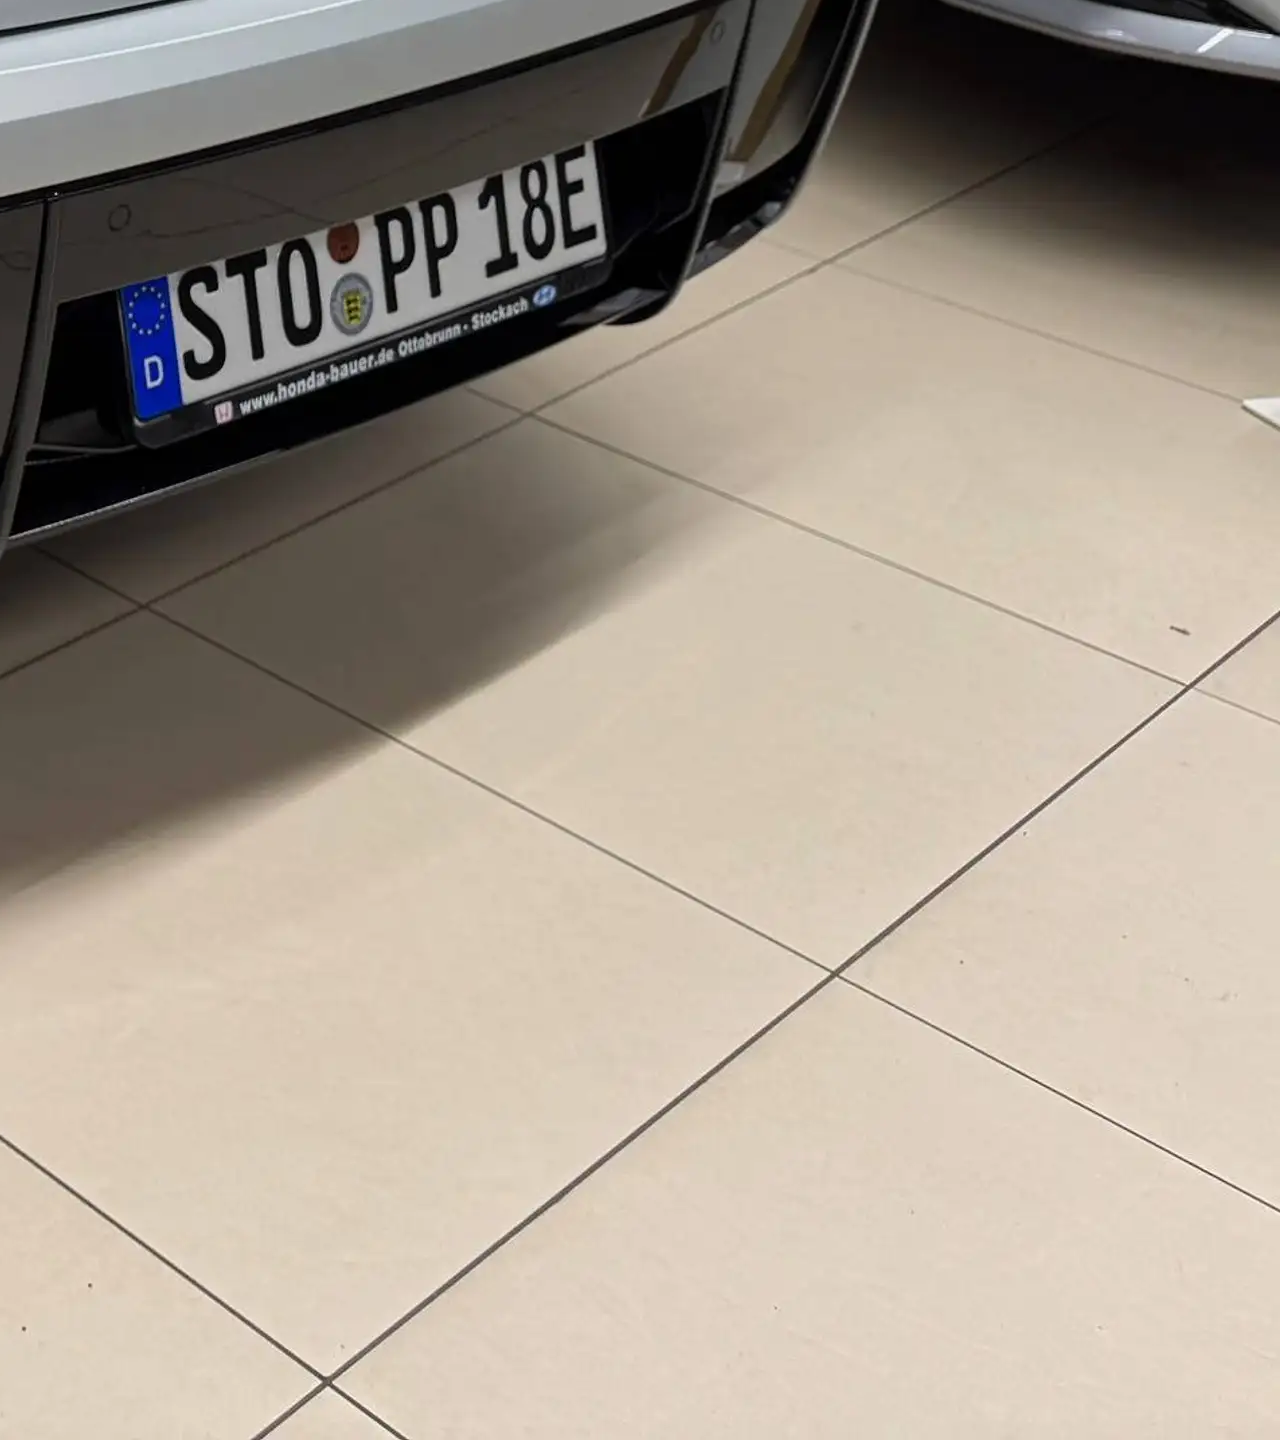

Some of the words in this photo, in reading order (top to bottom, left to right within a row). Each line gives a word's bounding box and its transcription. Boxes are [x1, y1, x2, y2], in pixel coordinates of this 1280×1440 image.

[177, 237, 323, 381] STO
[373, 192, 459, 315] PP
[477, 144, 597, 279] 18E
[143, 354, 165, 390] D
[239, 347, 395, 416] www.honda-bauer.de
[397, 323, 461, 358] Ottobrunn
[471, 296, 530, 331] Stockach
